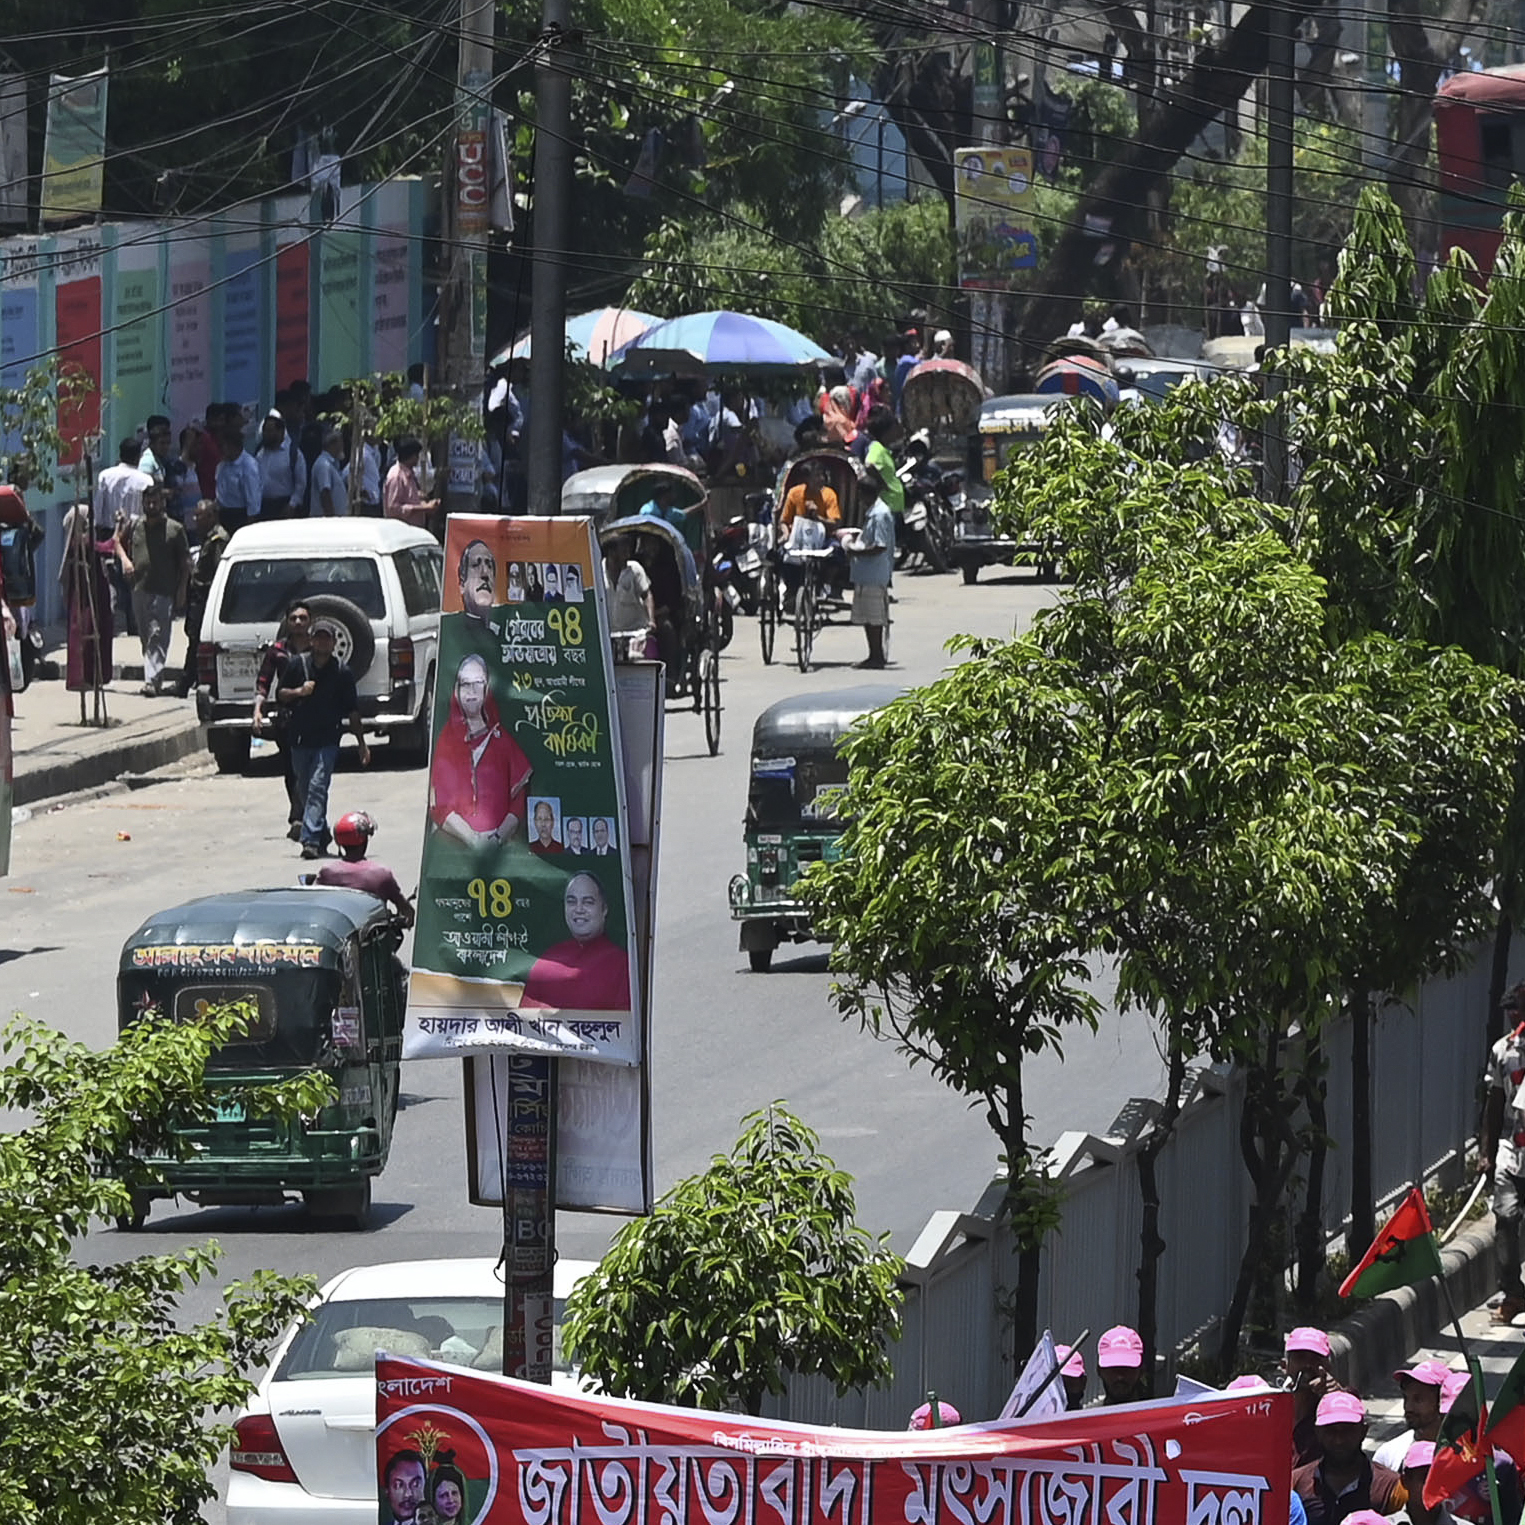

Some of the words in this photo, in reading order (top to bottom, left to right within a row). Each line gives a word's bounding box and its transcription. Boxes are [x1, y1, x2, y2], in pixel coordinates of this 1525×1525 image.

[547, 605, 584, 647] ৭৪
[467, 877, 513, 919] ৭৪
[418, 1016, 482, 1036] হায়দার
[484, 1012, 526, 1036] আলী
[528, 1018, 564, 1037] খান
